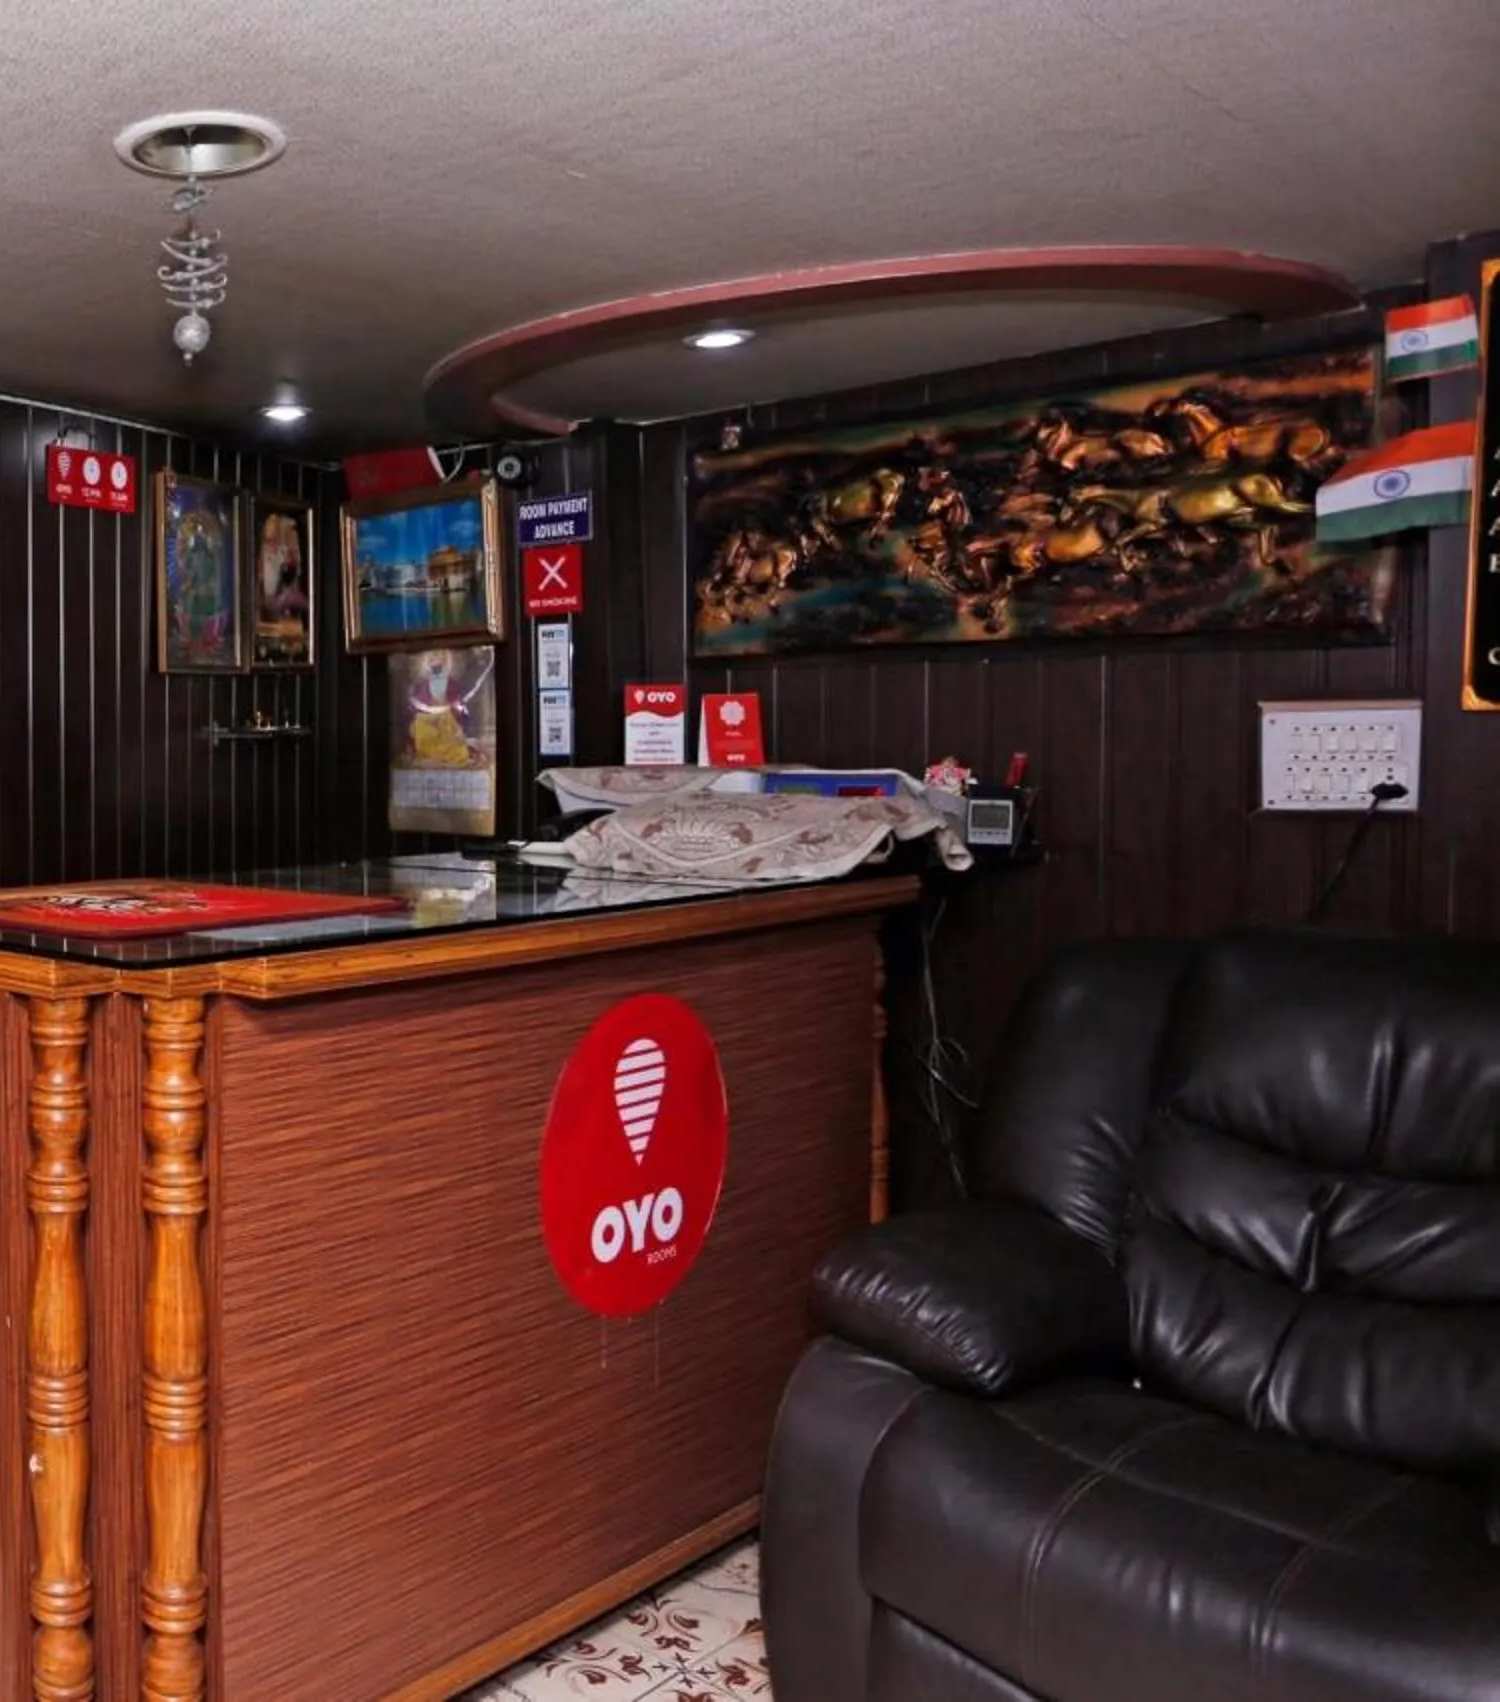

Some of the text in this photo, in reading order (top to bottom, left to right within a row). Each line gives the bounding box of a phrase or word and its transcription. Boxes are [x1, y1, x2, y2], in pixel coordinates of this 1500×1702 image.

[520, 498, 588, 520] ROOM PAYMENT
[534, 520, 575, 539] ADVANCE
[647, 691, 676, 703] OYO
[591, 1187, 684, 1263] OYO
